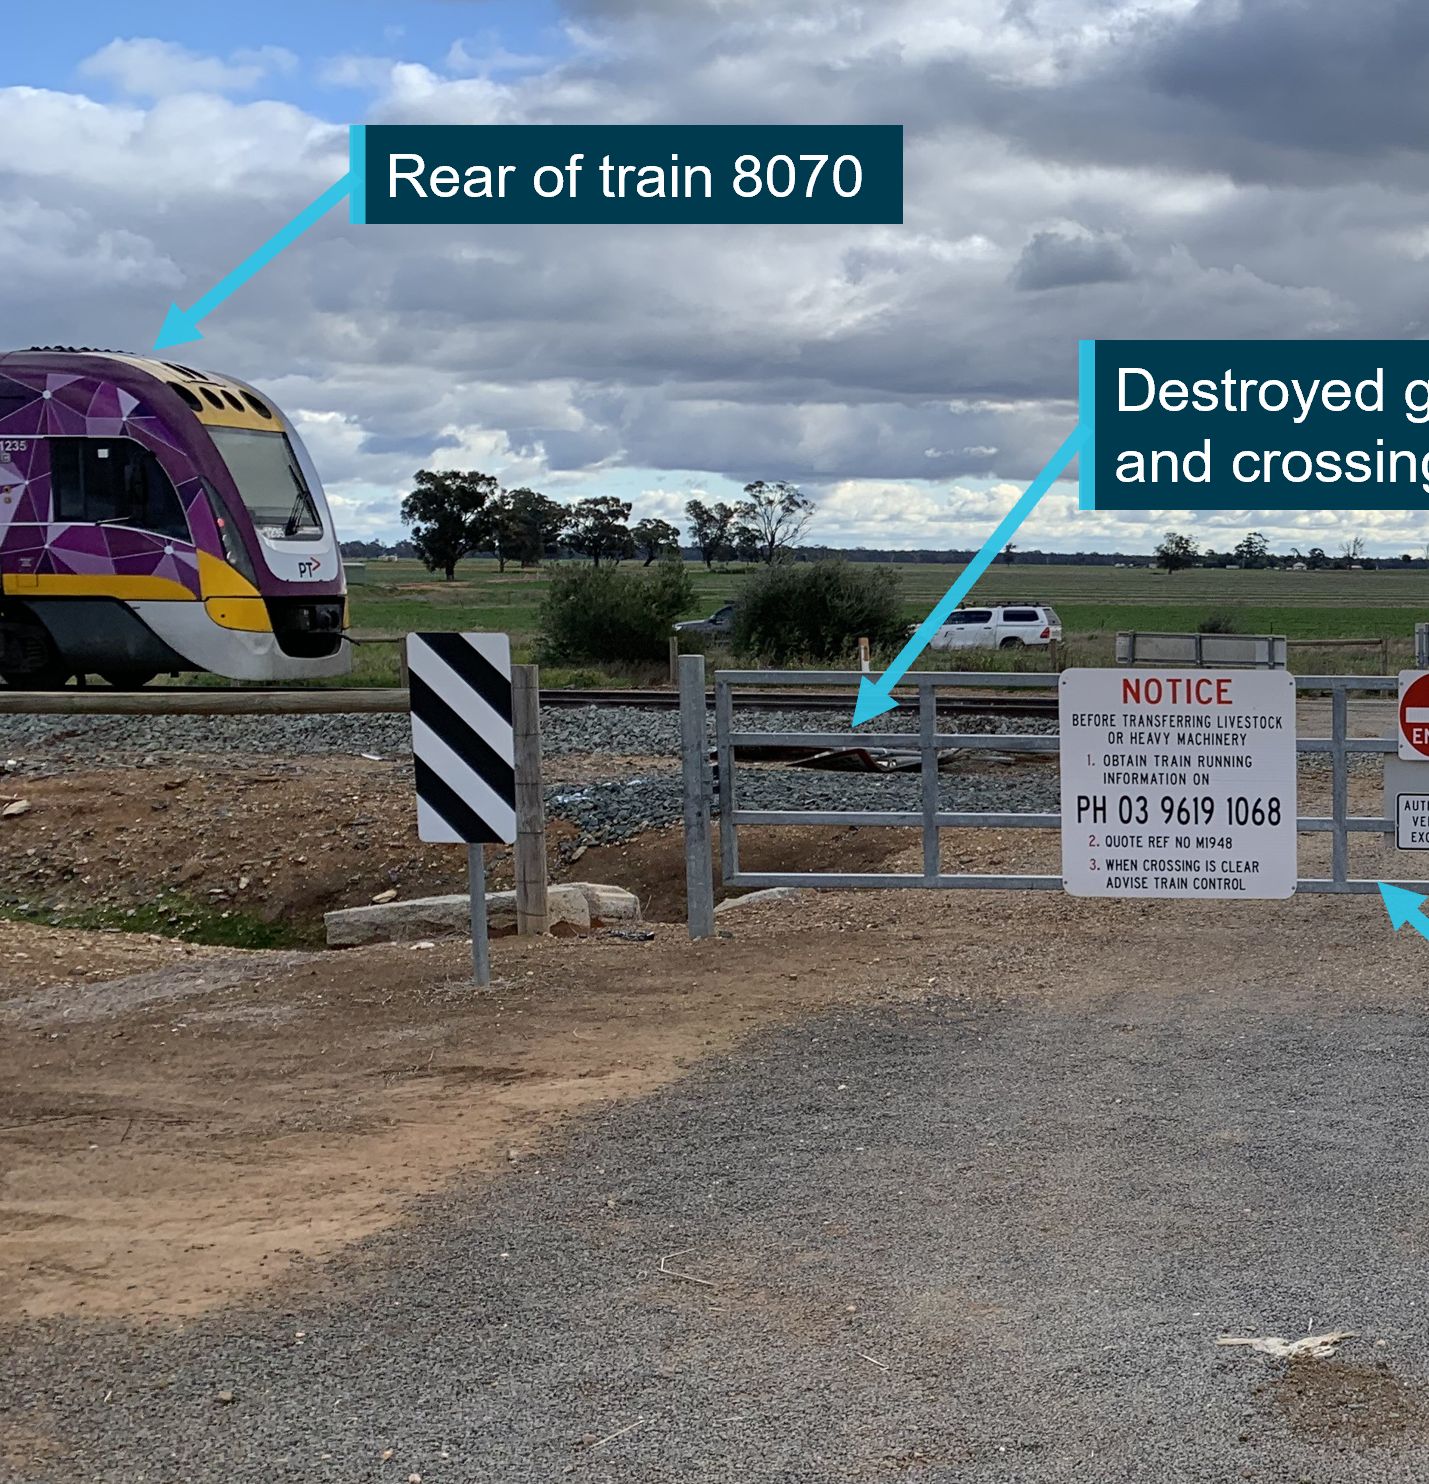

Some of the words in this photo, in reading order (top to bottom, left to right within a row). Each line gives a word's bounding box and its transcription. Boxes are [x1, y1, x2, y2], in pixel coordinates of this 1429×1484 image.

[0, 440, 27, 452] 1235
[1122, 678, 1233, 705] NOTICE
[1072, 713, 1117, 727] BEFORE
[1123, 714, 1211, 729] TRANSFERRING
[1216, 715, 1283, 730] LIVESTOCK
[1108, 731, 1124, 745] OR
[1130, 731, 1171, 746] HEAVY
[1177, 733, 1247, 747] MACHINERY
[1086, 753, 1095, 767] 1.
[1103, 754, 1147, 768] OBTAIN
[1154, 754, 1192, 768] TRAIN
[1197, 755, 1253, 768] RUNNING
[1103, 772, 1187, 786] INFORMATION
[1193, 772, 1210, 786] ON
[1077, 795, 1107, 824] PH
[1118, 795, 1149, 825] 03
[1160, 795, 1215, 826] 9619
[1227, 796, 1282, 827] 1068
[1088, 834, 1100, 848] 2.
[1105, 835, 1143, 848] QUOTE
[1148, 835, 1170, 848] REF
[1175, 836, 1191, 849] NO
[1196, 836, 1233, 850] M1948
[1089, 858, 1100, 871] 3.
[1105, 859, 1139, 872] WHEN
[1143, 859, 1201, 872] CROSSING
[1205, 859, 1217, 873] IS
[1221, 860, 1260, 874] CLEAR
[1106, 876, 1149, 890] ADVISE
[1154, 877, 1189, 890] TRAIN
[1193, 877, 1247, 891] CONTROL
